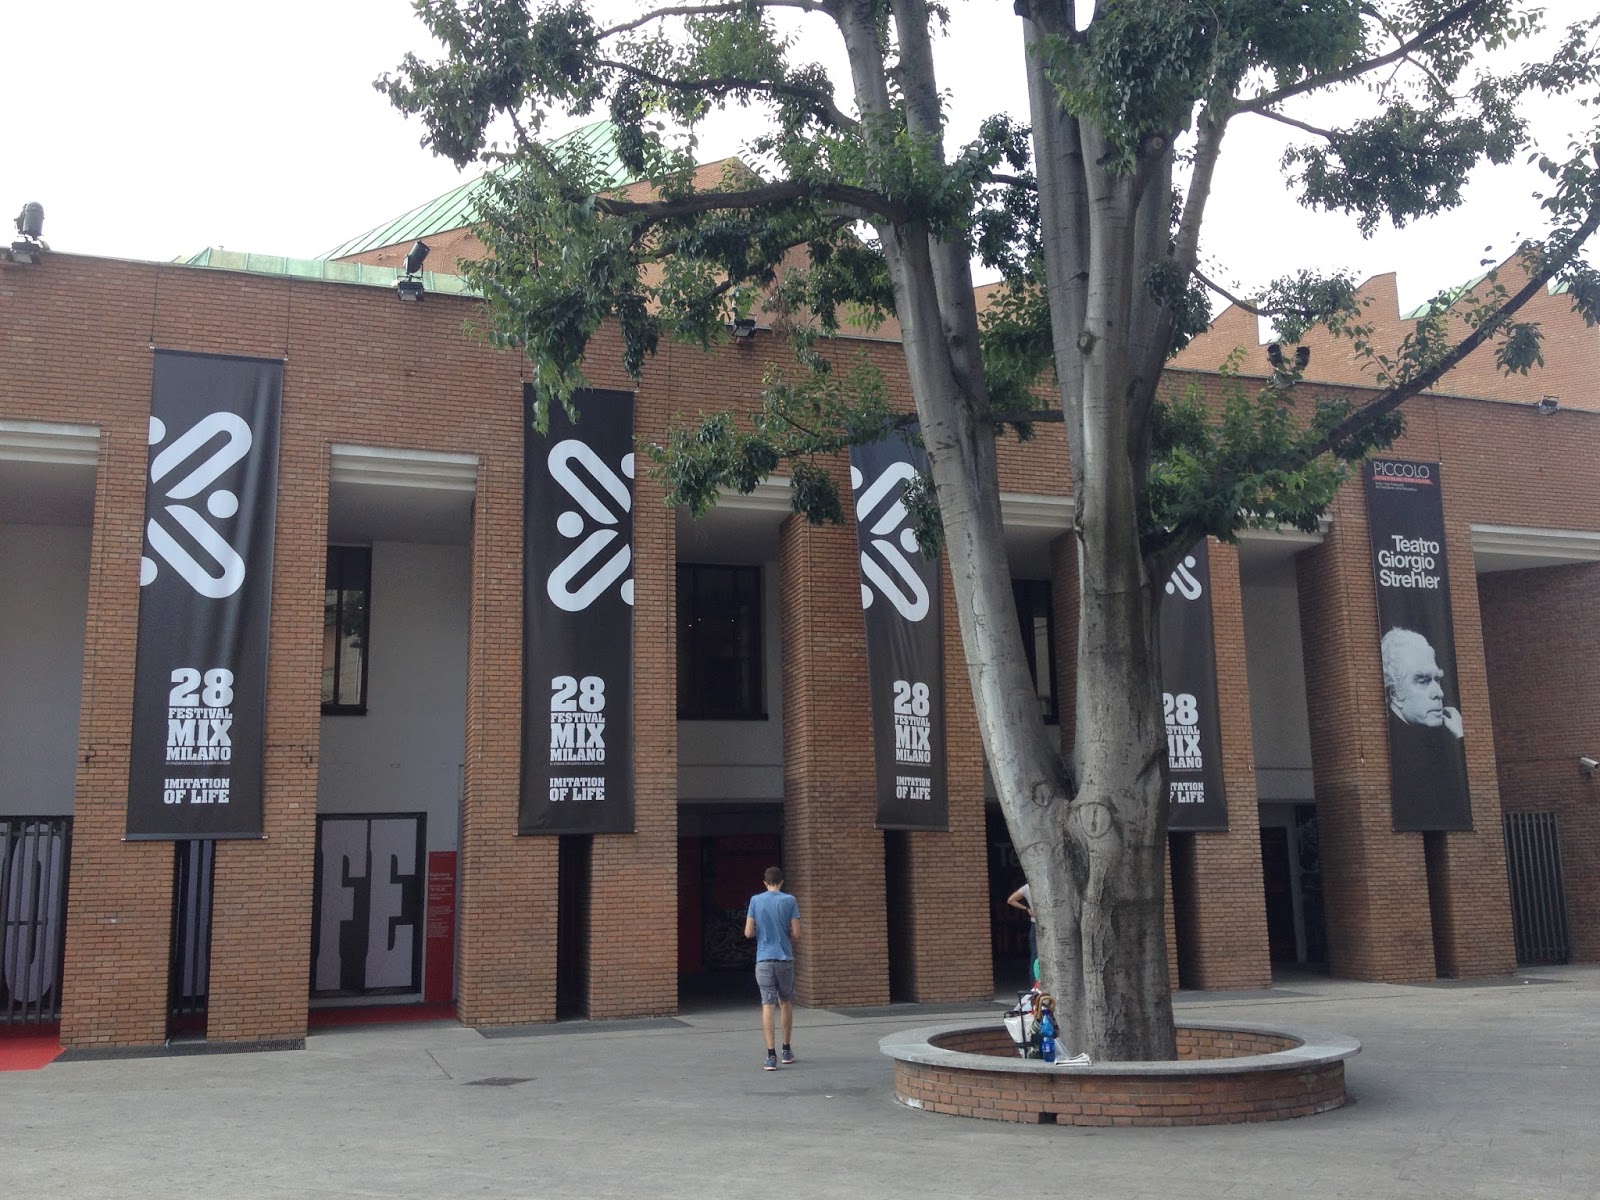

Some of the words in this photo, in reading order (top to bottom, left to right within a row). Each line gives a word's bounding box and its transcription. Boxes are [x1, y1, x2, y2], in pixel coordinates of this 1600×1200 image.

[1373, 461, 1430, 479] PICCOLO
[1391, 534, 1440, 554] Teatro
[1378, 549, 1435, 573] Giorgio
[1379, 569, 1440, 589] Strehler
[169, 667, 234, 707] 28
[551, 675, 606, 712] 28
[893, 680, 930, 717] 28
[168, 708, 233, 719] FESTIVAL
[1162, 692, 1199, 725] 28
[550, 712, 605, 723] FESTIVAL
[894, 714, 931, 727] FESTIVAL
[167, 719, 232, 746] MIX
[550, 723, 605, 748] MIX
[895, 725, 931, 750] MIX
[166, 747, 231, 761] MILANO
[550, 748, 605, 761] MILANO
[895, 749, 931, 763] MILANO
[1168, 757, 1203, 768] ILANO
[164, 778, 230, 789] IMITATION
[549, 777, 605, 787] IMITATION
[896, 776, 931, 787] IMITATION
[163, 789, 187, 804] OF
[190, 789, 230, 803] LIFE
[549, 788, 568, 801] OF
[572, 788, 605, 800] LIFE
[896, 786, 908, 799] OF
[910, 787, 931, 800] LIFE
[1177, 790, 1205, 803] LIFE
